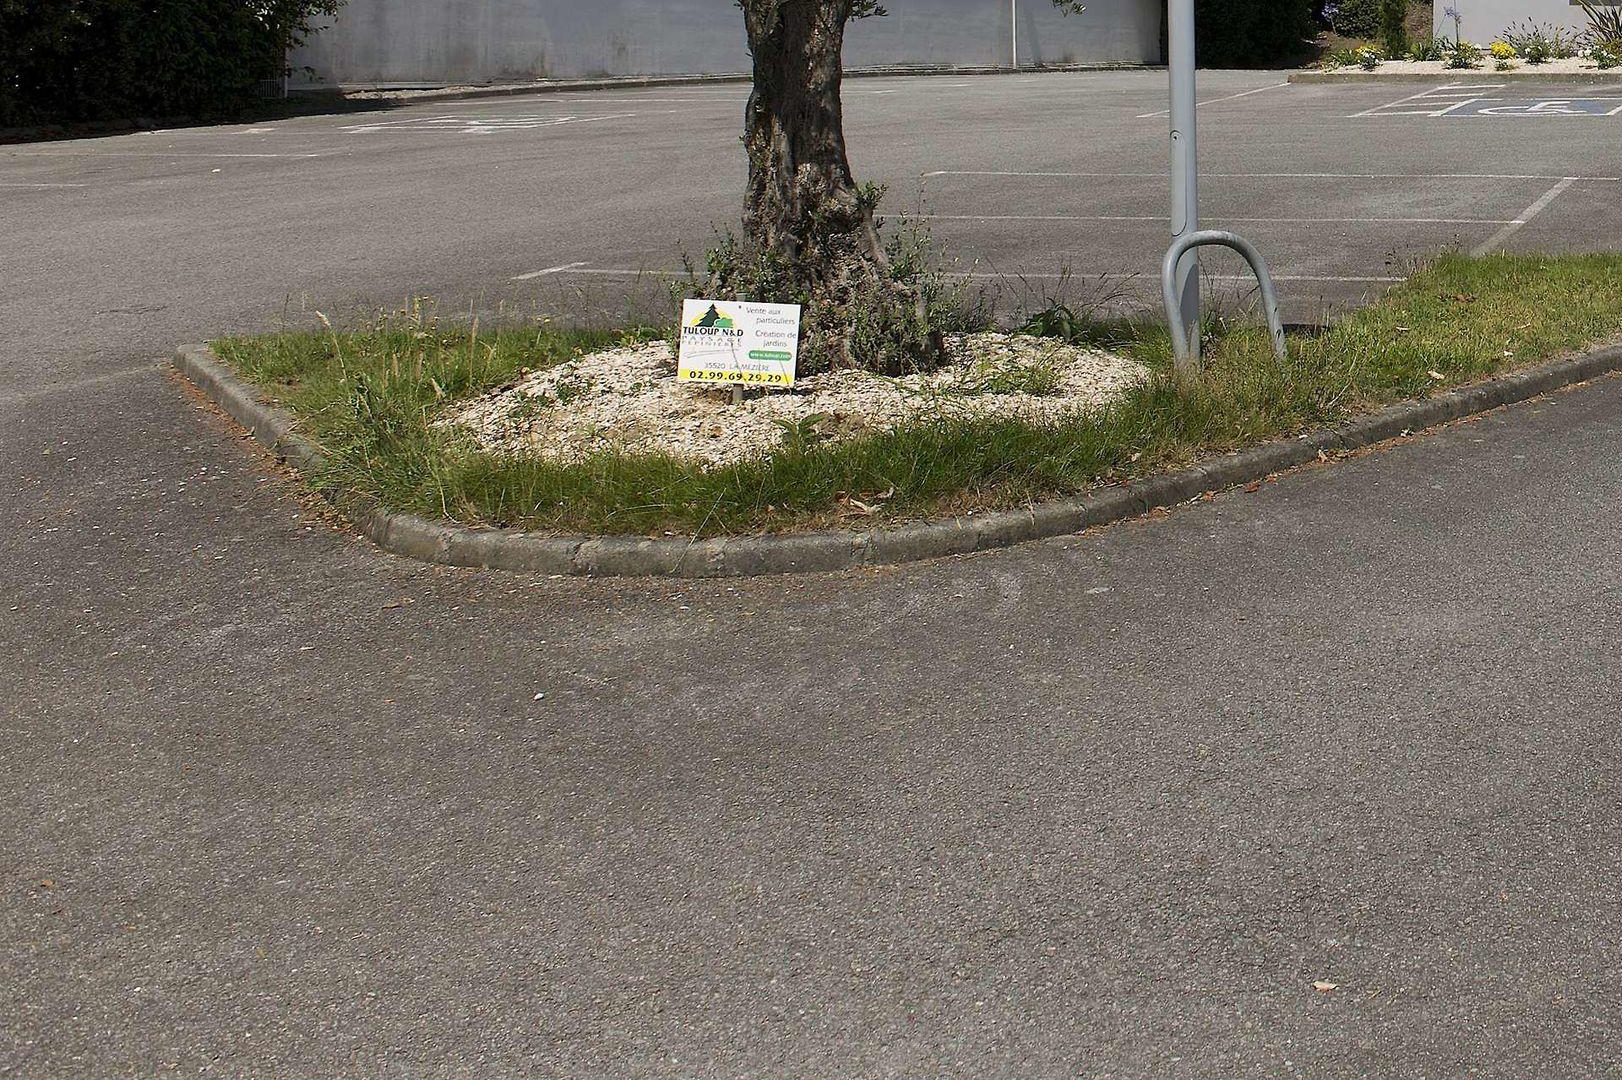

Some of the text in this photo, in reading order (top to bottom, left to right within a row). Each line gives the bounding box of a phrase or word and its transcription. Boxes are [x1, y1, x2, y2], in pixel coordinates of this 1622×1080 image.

[746, 307, 767, 315] Vente
[683, 326, 720, 336] TULOUP
[763, 339, 787, 348] jardins
[689, 370, 782, 382] 02.99.69.29.29
